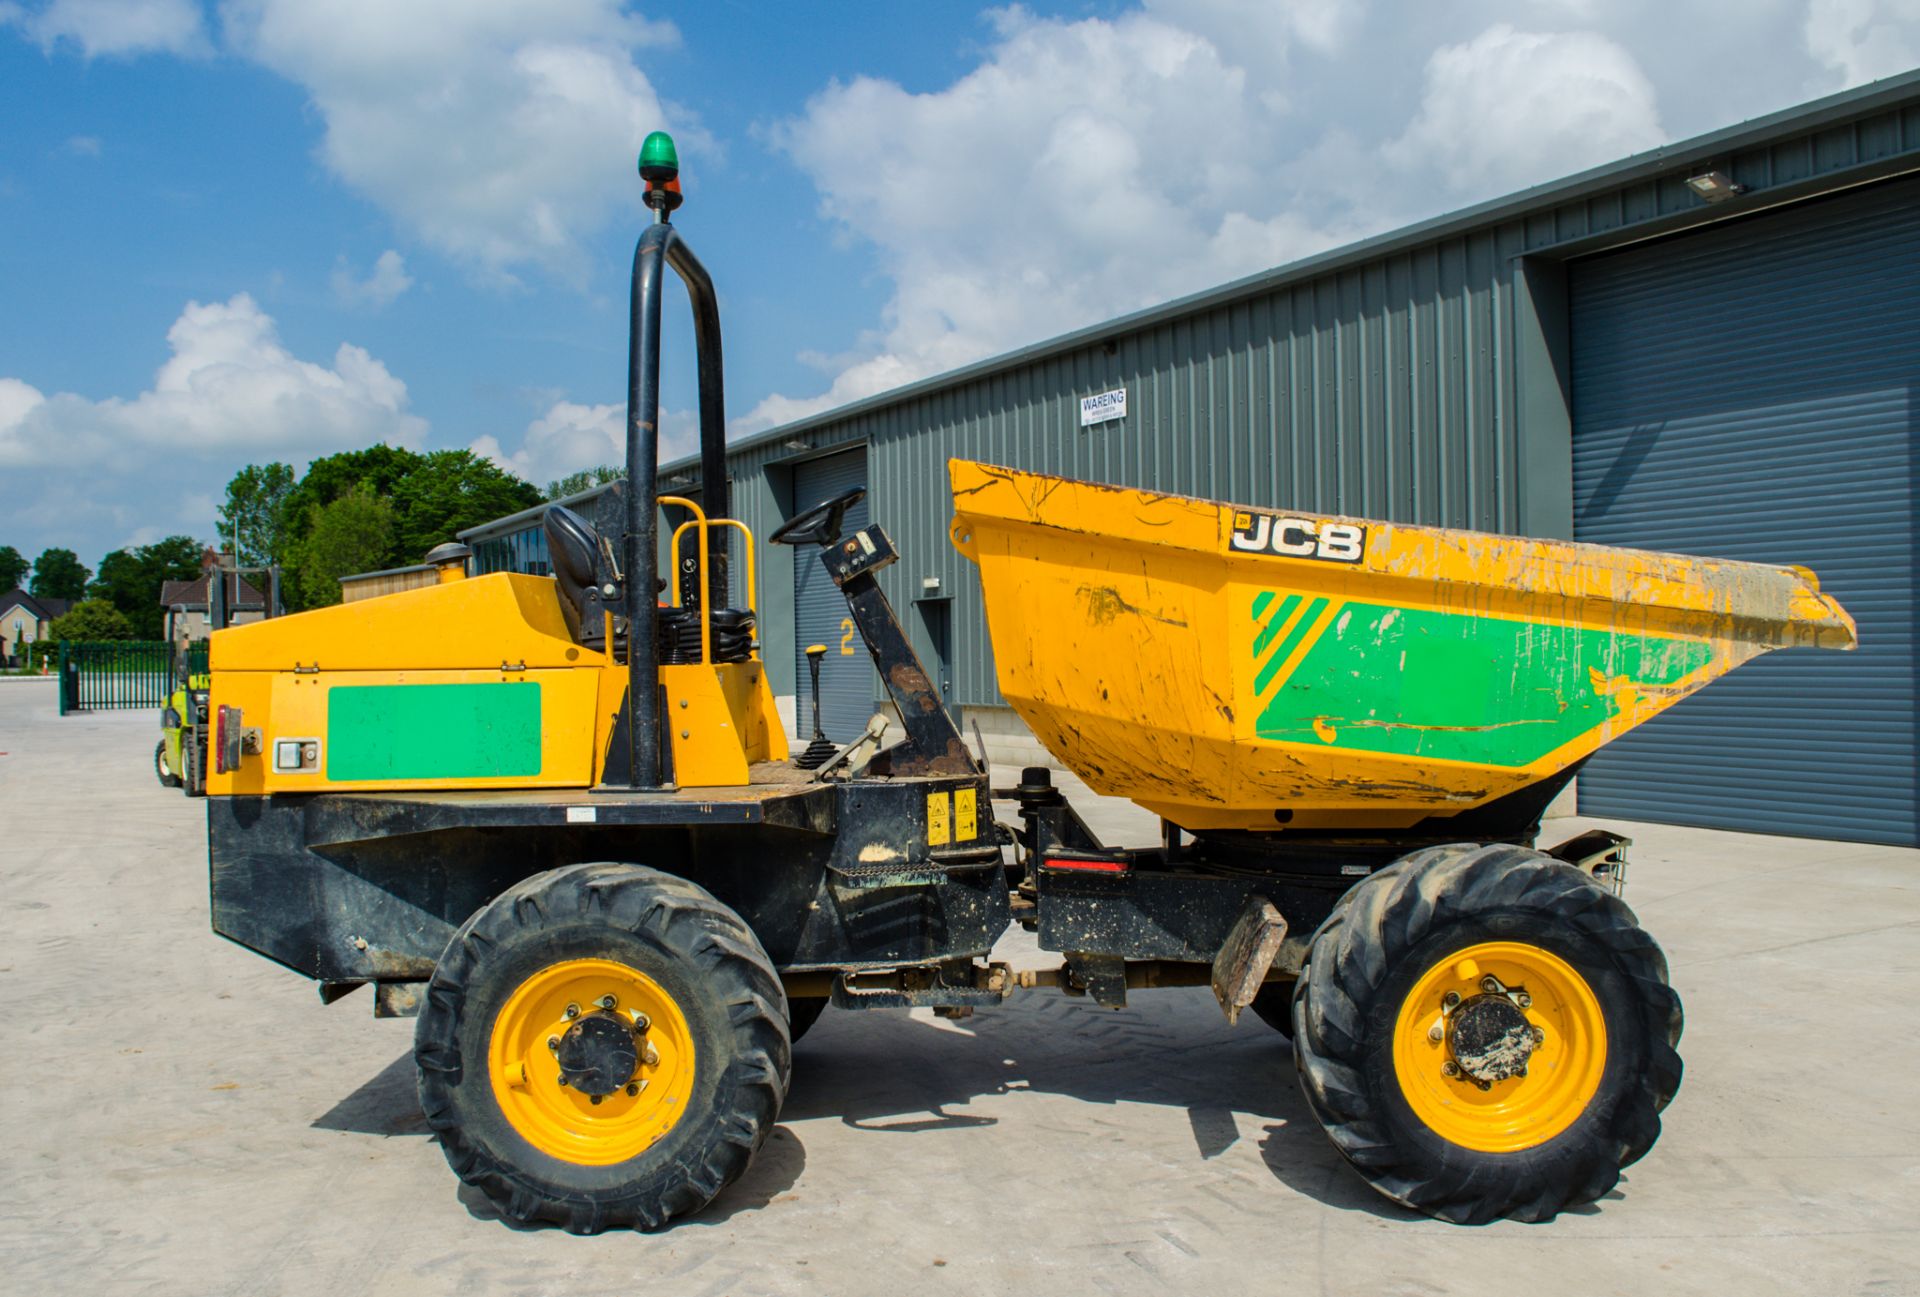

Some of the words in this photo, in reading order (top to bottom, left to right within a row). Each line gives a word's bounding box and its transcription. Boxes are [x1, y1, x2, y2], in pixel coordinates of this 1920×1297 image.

[1083, 391, 1124, 411] WAREING
[1233, 515, 1362, 560] JCB
[841, 618, 854, 656] 2
